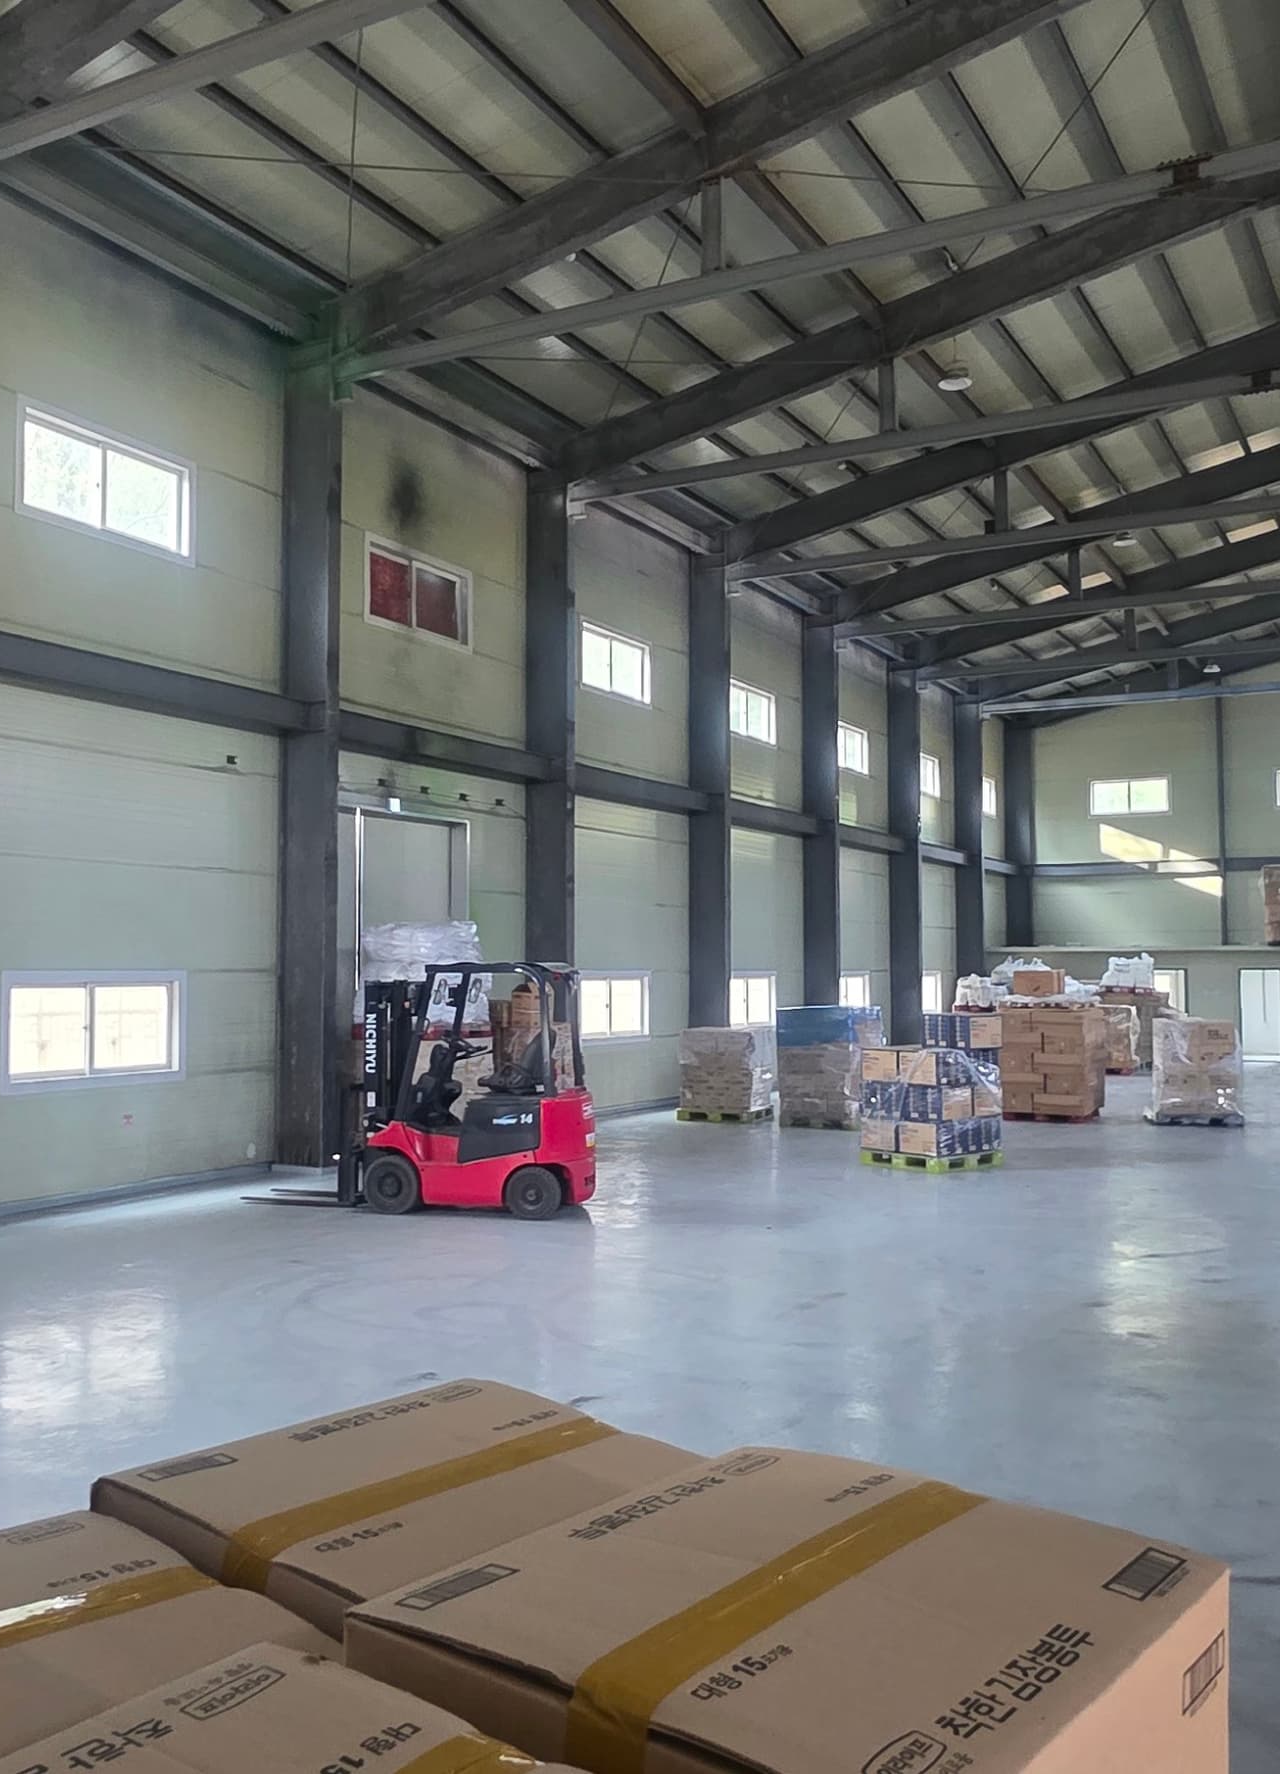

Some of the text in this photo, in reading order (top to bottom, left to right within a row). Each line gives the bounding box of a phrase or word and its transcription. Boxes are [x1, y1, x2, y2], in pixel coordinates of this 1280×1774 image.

[365, 1013, 377, 1074] NICHIYU
[520, 1112, 533, 1124] 14
[690, 1672, 743, 1701] 대형
[934, 1623, 1095, 1739] 착한 김장봉투
[60, 1718, 174, 1770] 착한
[360, 1722, 423, 1756] 대형
